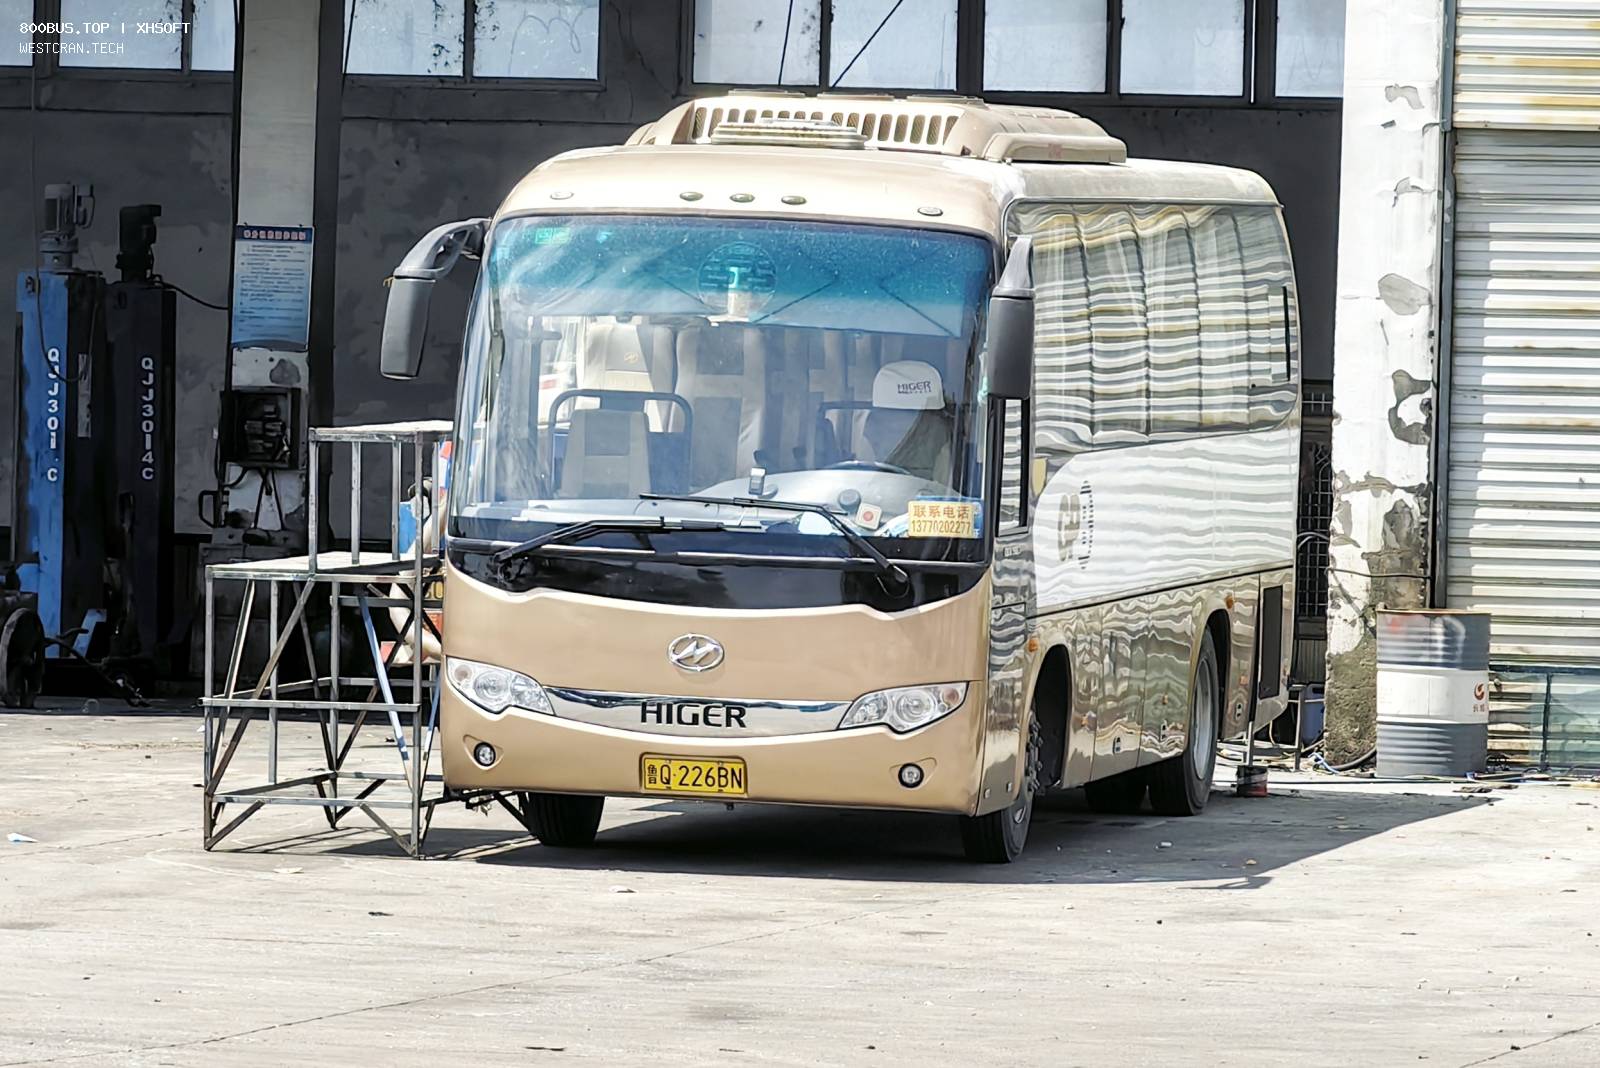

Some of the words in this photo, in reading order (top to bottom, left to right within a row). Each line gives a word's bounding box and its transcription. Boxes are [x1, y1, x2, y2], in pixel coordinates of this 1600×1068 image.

[141, 357, 154, 480] QJJ3014C
[913, 504, 970, 520] 联系电话
[641, 701, 747, 728] HIGER
